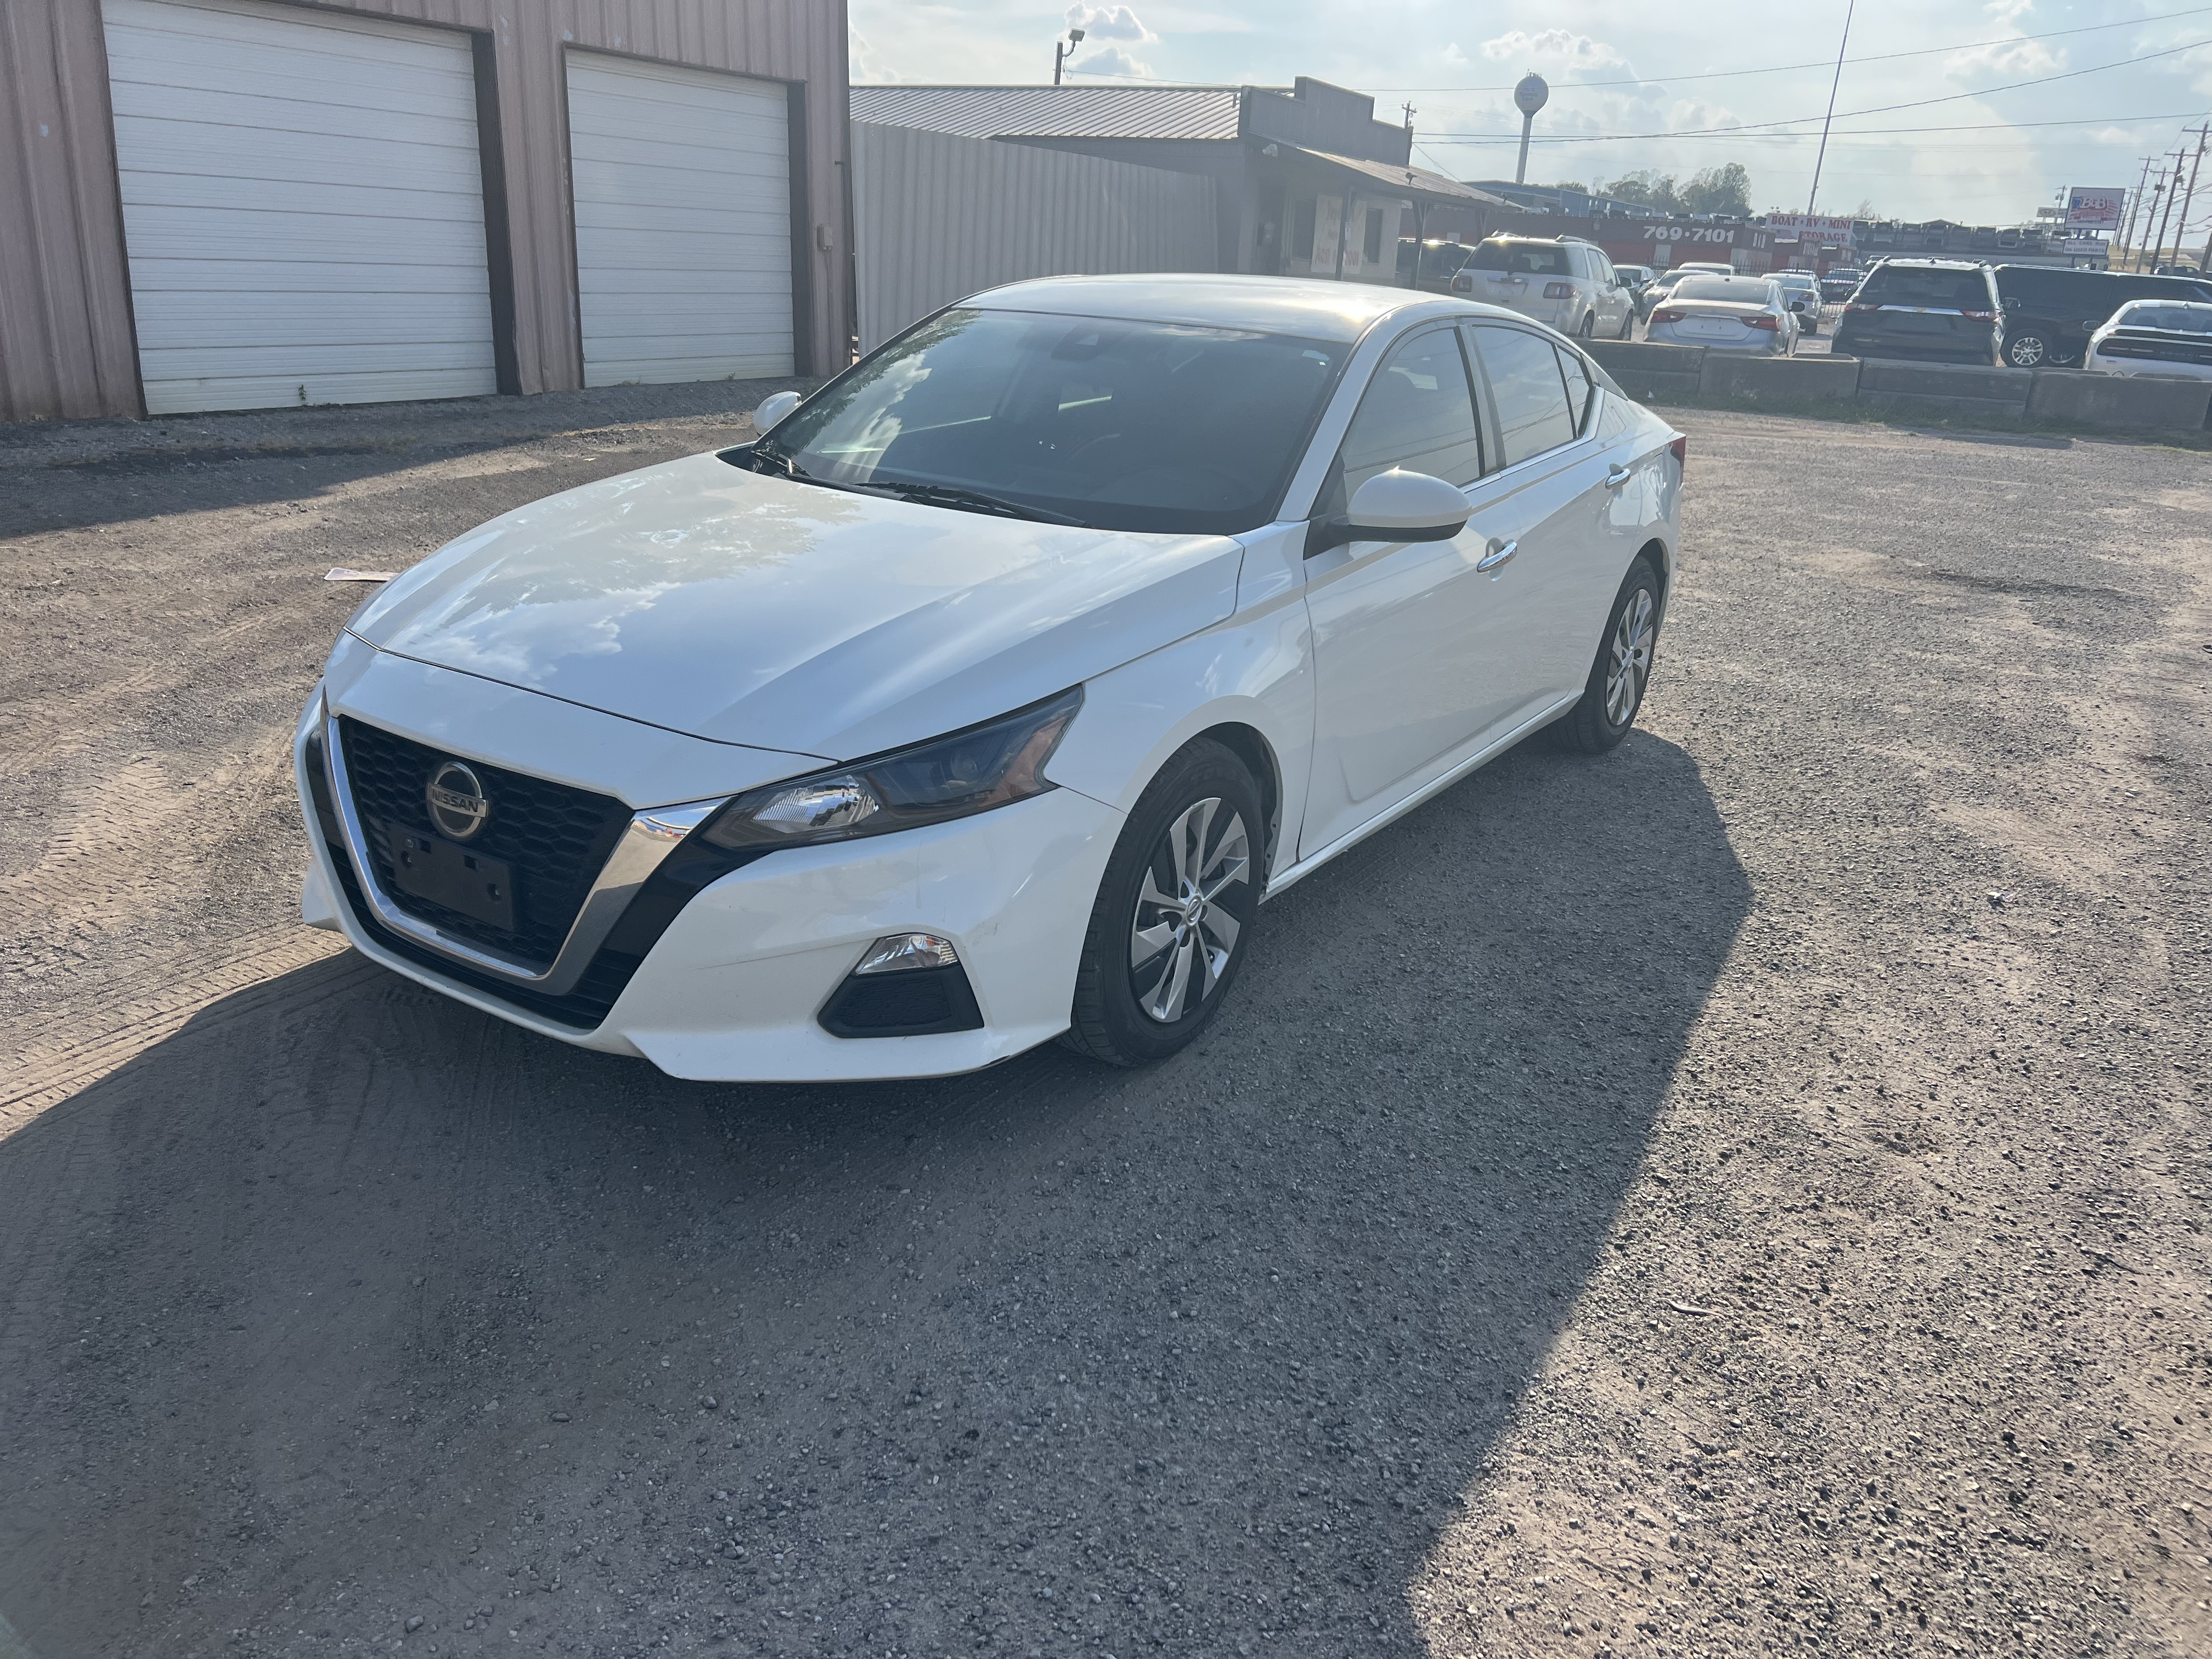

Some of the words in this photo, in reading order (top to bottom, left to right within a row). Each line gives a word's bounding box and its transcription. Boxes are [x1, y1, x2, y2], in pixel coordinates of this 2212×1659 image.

[1771, 216, 1798, 226] BOAT
[1805, 218, 1820, 227] RV
[1828, 219, 1851, 229] MINI
[431, 788, 478, 812] NISSAN
